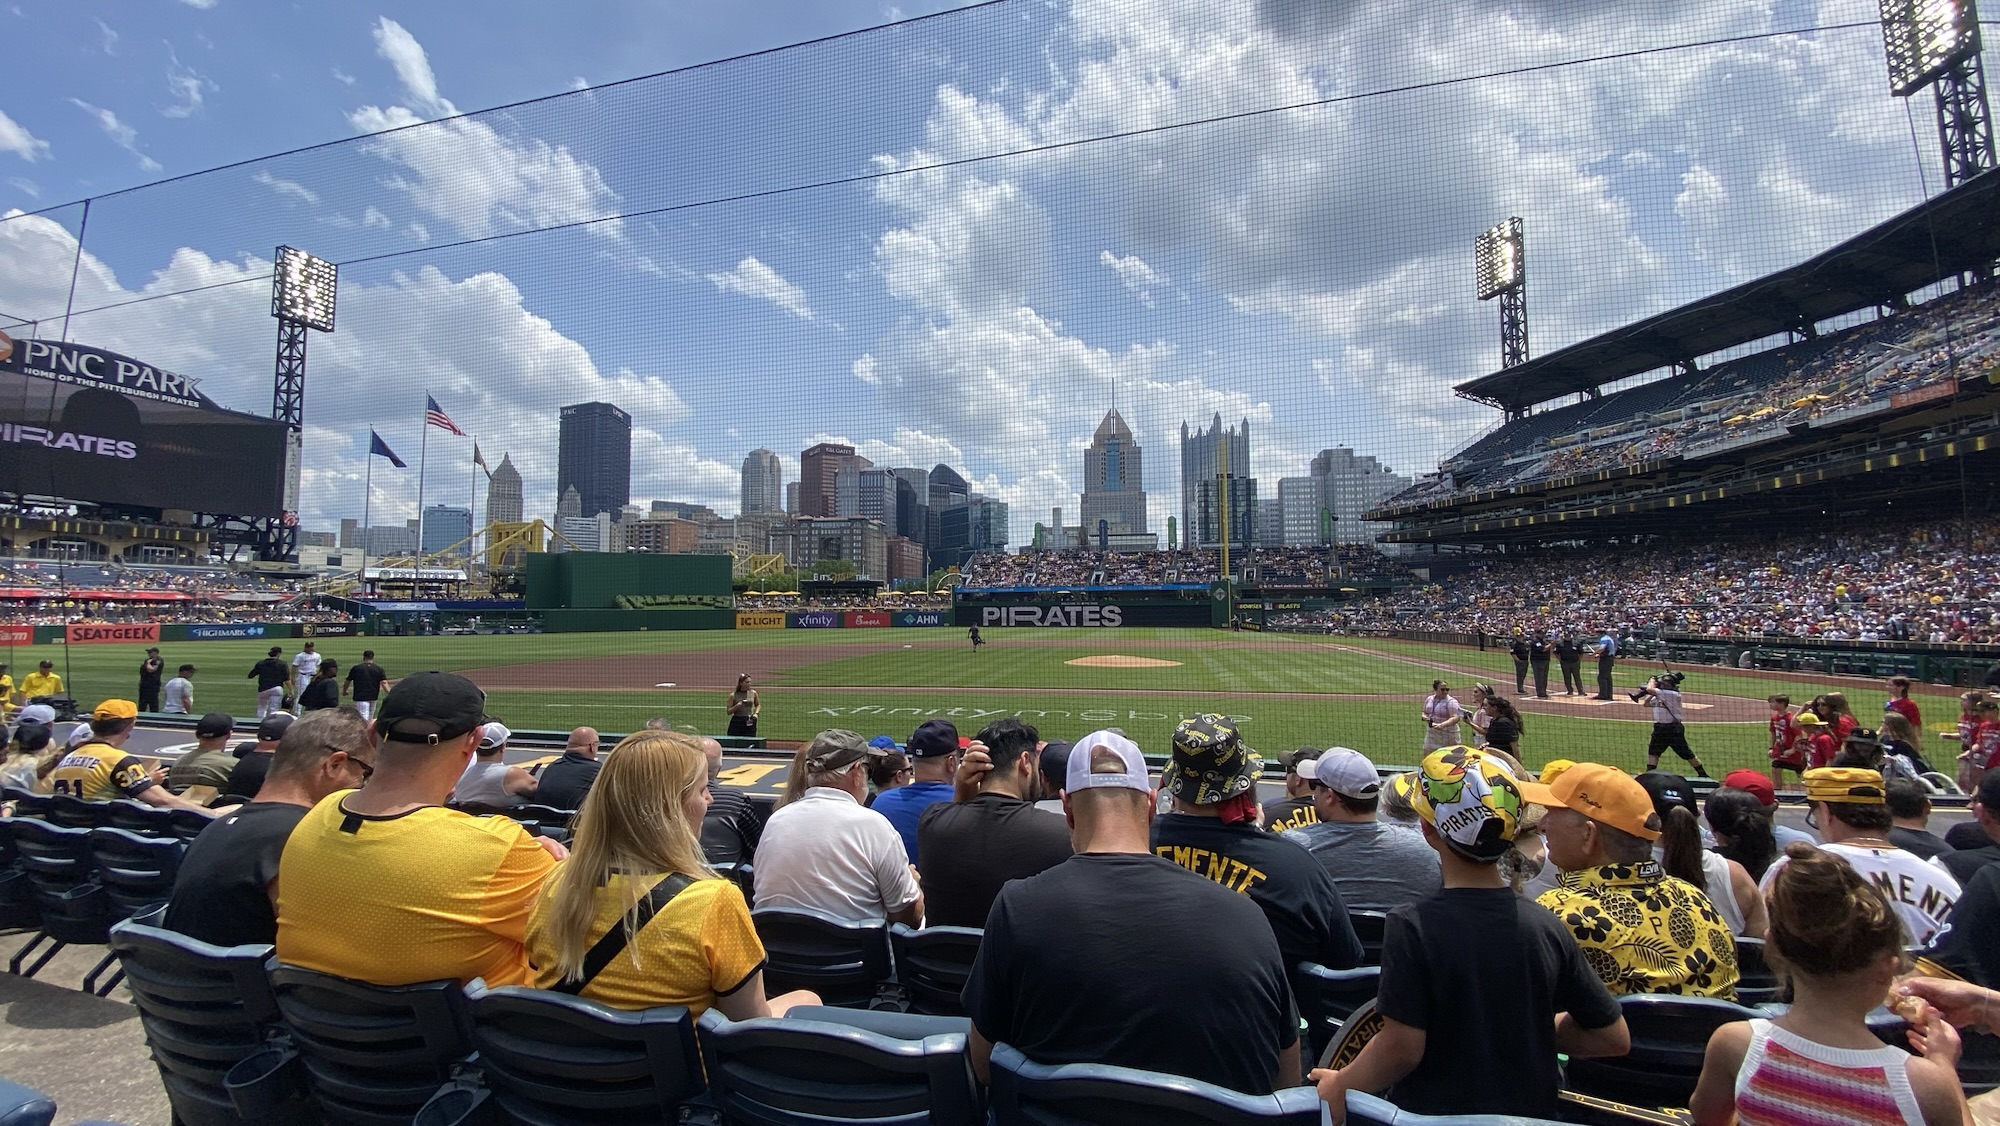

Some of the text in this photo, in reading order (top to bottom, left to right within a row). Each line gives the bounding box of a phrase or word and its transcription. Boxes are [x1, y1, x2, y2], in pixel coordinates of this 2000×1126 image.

[22, 340, 203, 399] PNC PARK
[24, 367, 200, 408] HOME OF THE PITTSBURGH PIRATES
[0, 423, 137, 459] IRATES
[741, 617, 782, 626] IC LIGHT
[798, 615, 832, 627] xfinity
[917, 614, 938, 624] AHN
[983, 605, 1122, 627] PIRATES
[73, 627, 154, 641] SEATGEEK
[194, 628, 245, 637] HIGHMARK
[316, 626, 346, 634] BETMGM
[807, 705, 1007, 719] xfinity
[1649, 916, 1662, 935] P
